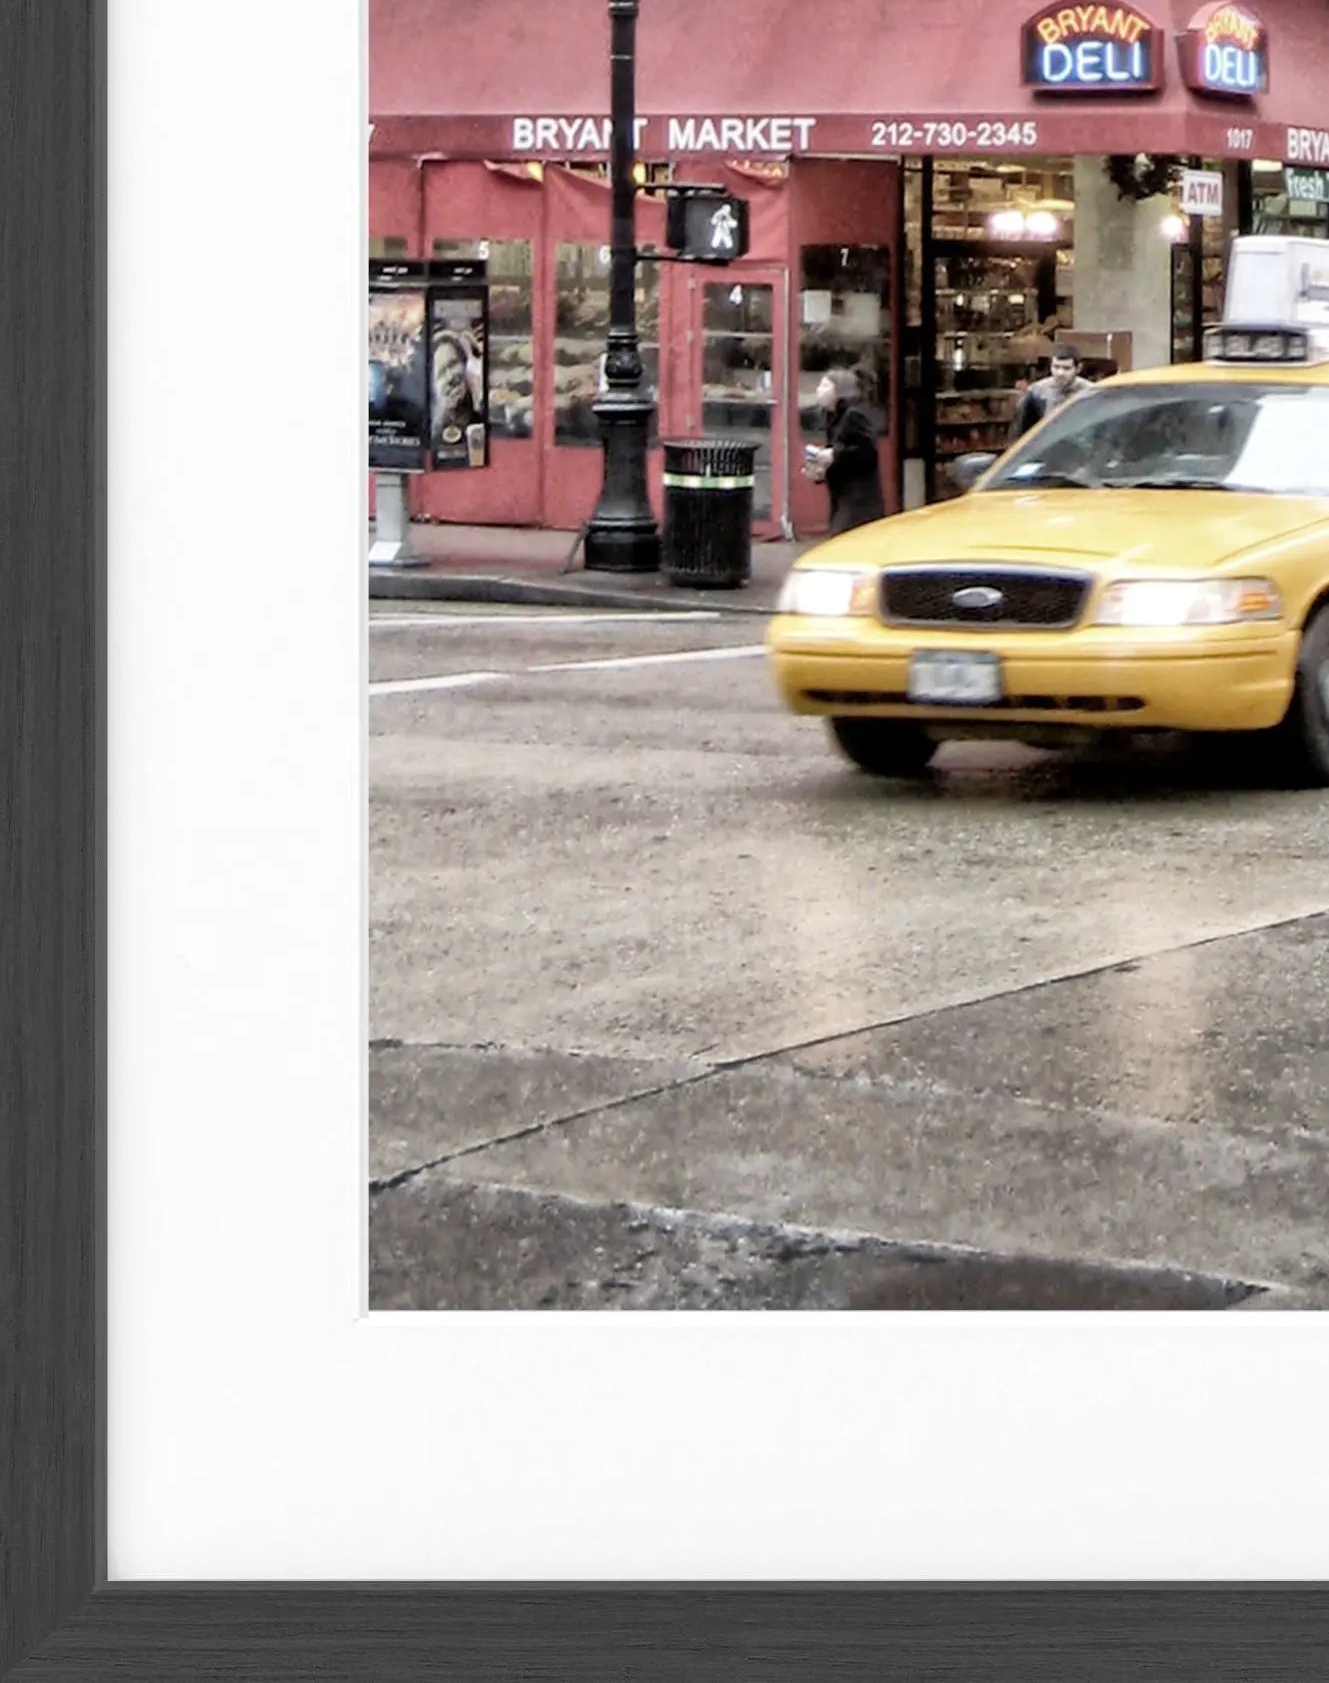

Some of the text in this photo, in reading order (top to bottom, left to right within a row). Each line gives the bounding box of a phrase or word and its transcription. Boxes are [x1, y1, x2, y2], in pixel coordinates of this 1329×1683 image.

[1037, 5, 1150, 43] BRYANT
[1206, 9, 1259, 51] BRYANT
[1042, 41, 1143, 82] DELI
[1205, 43, 1257, 87] DELI
[668, 118, 816, 150] MARKET
[871, 121, 1037, 148] 212-730-2345
[1227, 128, 1253, 150] 1017
[1187, 181, 1219, 206] ATM
[478, 240, 490, 260] 5
[729, 284, 742, 305] 4
